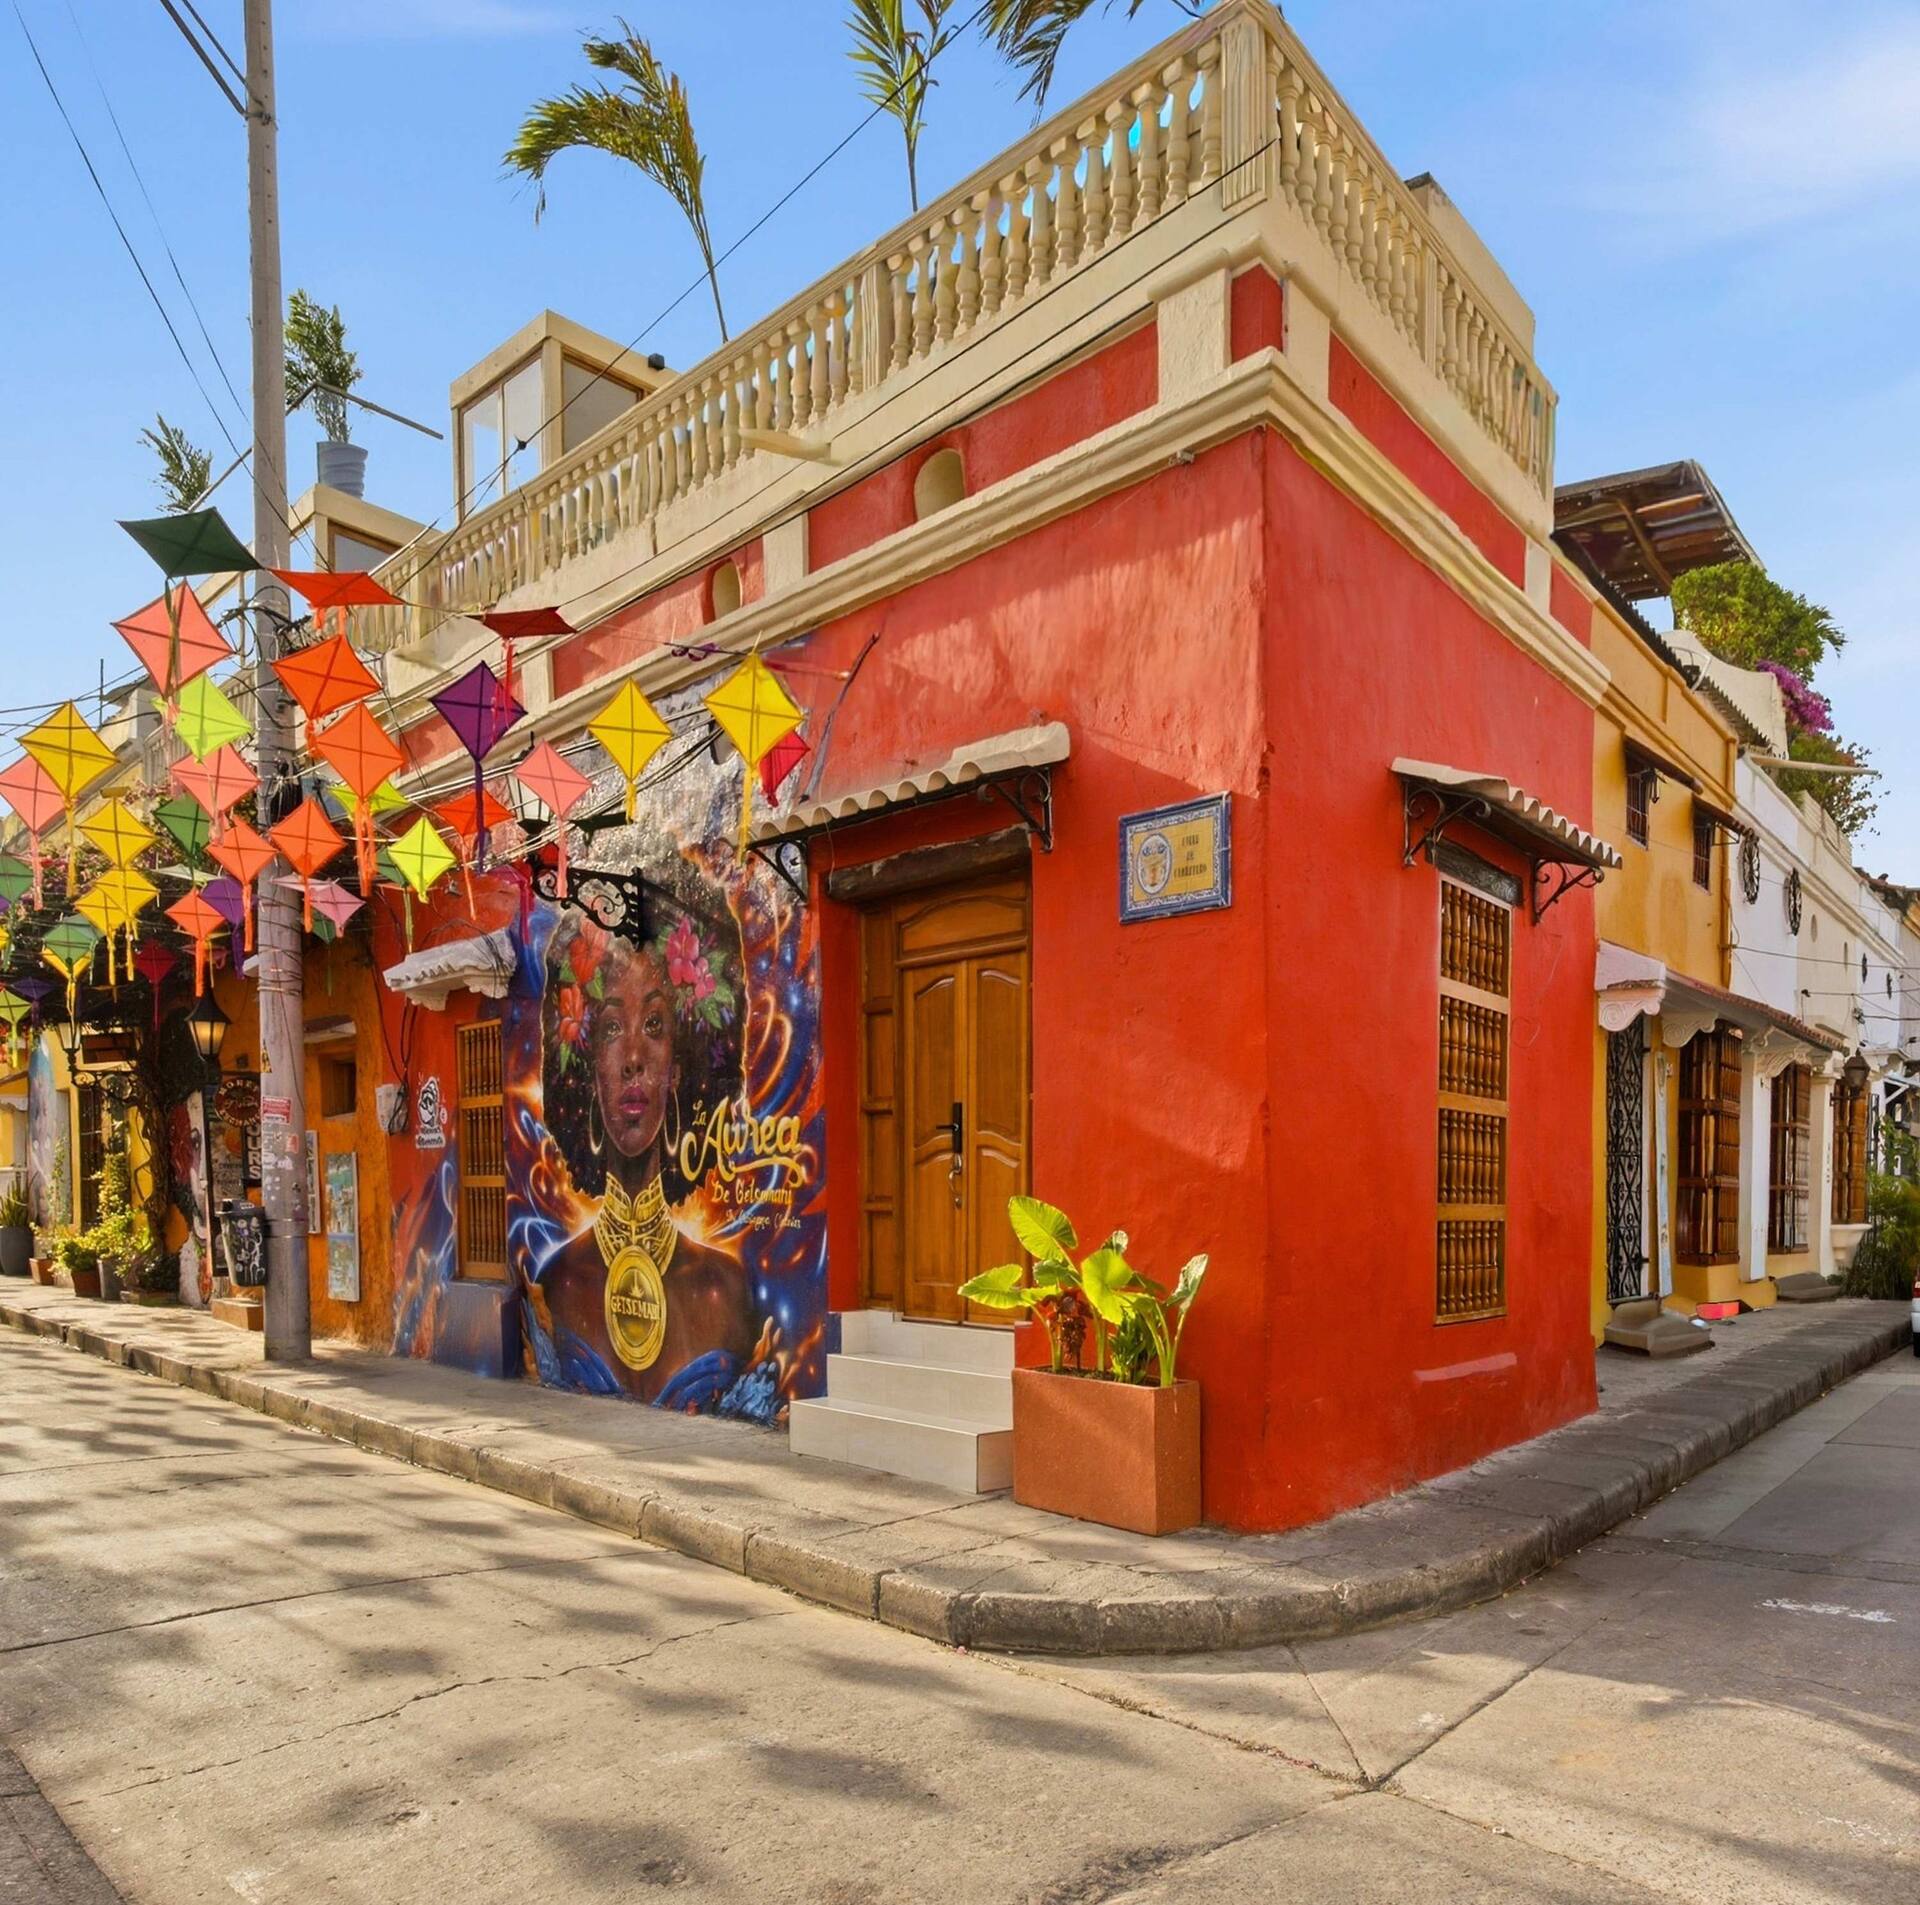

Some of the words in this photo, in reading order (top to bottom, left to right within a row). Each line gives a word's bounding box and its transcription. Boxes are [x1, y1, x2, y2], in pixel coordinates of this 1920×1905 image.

[692, 1099, 707, 1126] La
[681, 1096, 804, 1187] Aurea
[711, 1180, 730, 1203] De
